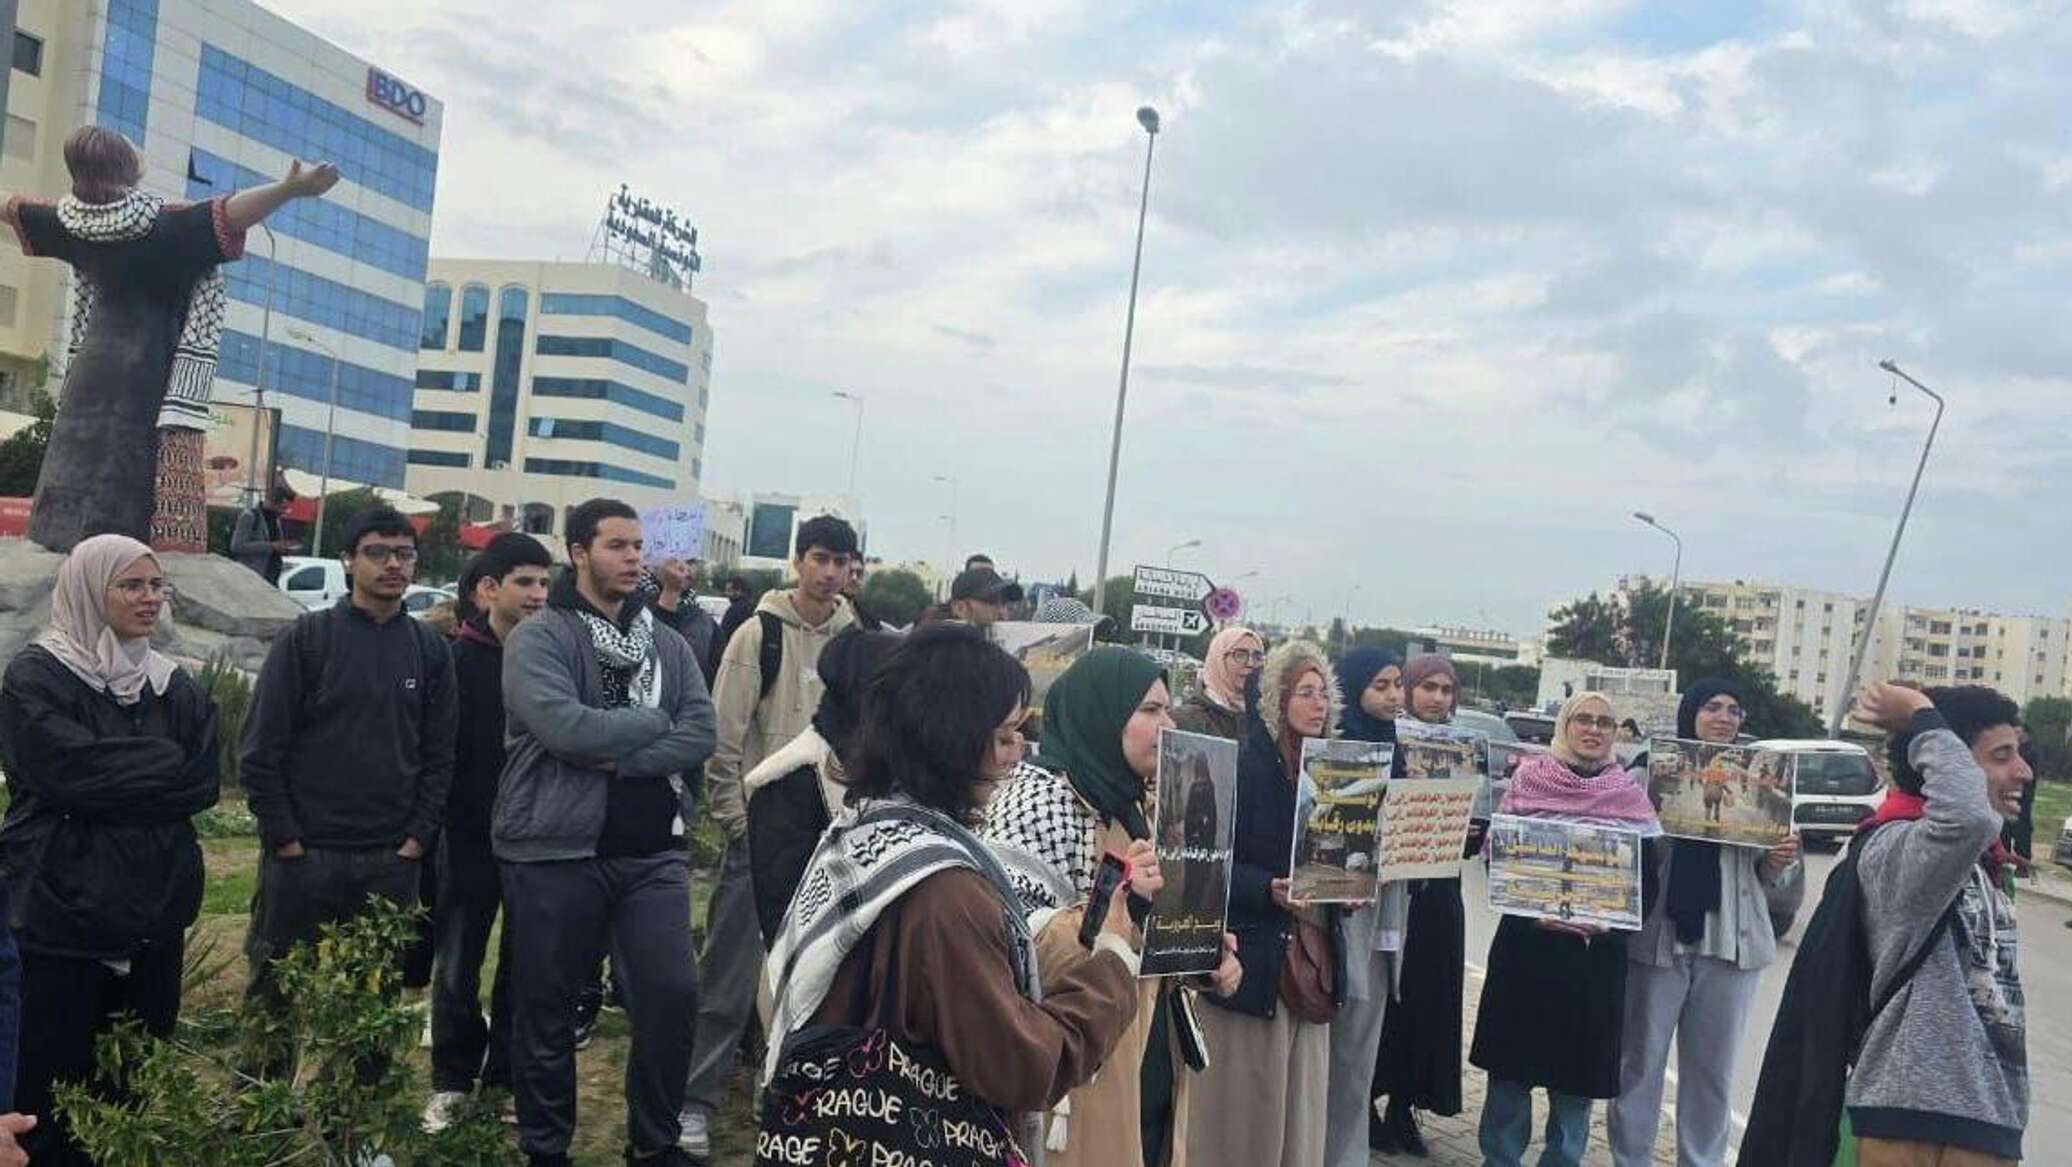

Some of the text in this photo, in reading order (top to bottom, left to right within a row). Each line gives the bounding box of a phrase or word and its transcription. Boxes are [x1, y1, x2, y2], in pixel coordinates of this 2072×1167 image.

[374, 71, 426, 116] BDO
[888, 1041, 961, 1101] PRAGUE
[812, 1087, 903, 1125] RAGUE
